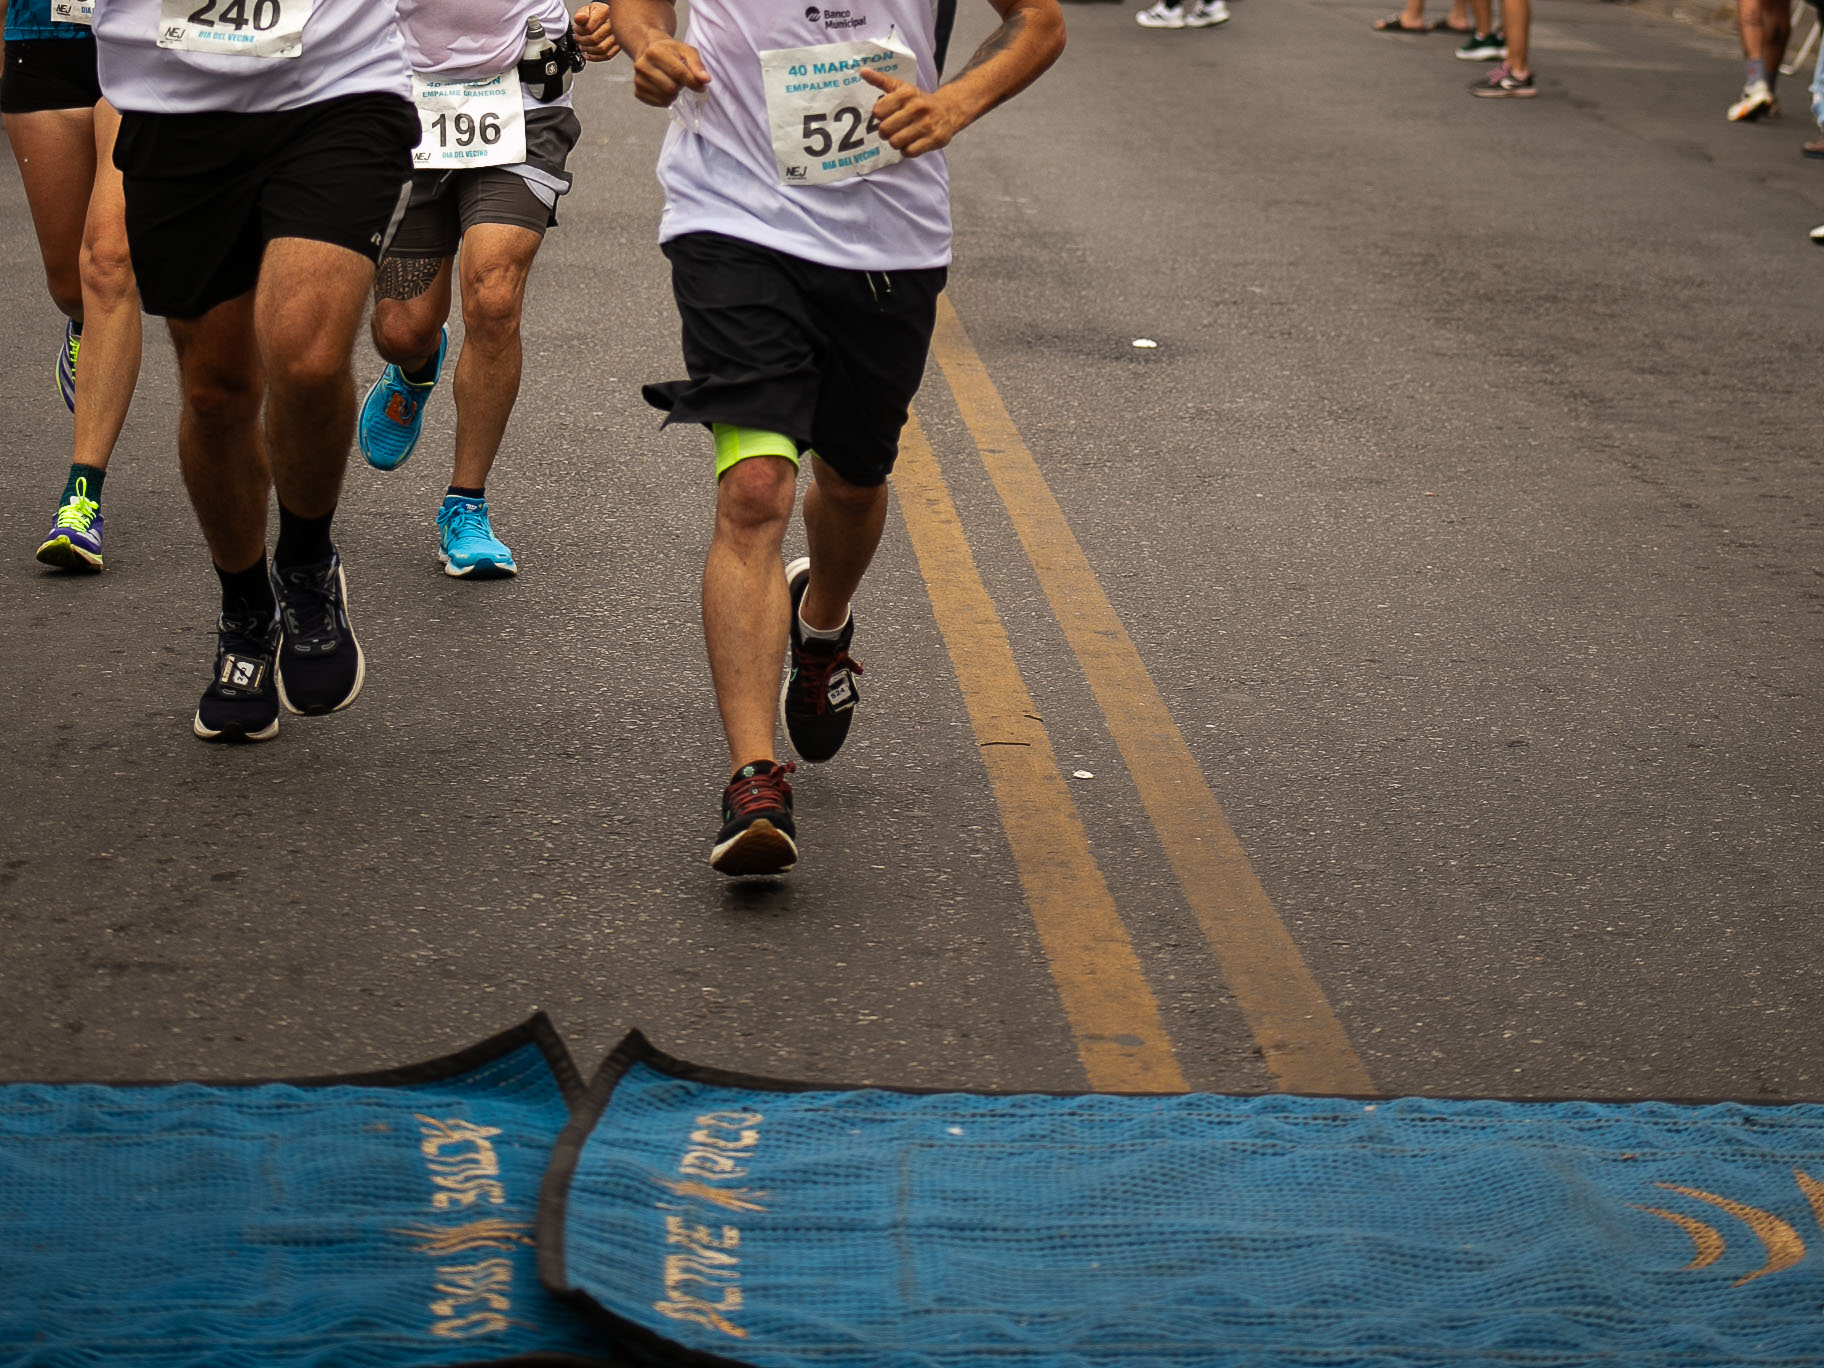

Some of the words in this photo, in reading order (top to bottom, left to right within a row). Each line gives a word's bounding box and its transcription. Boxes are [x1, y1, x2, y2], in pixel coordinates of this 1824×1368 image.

[56, 4, 72, 14] NEJ
[824, 9, 851, 20] Banco
[825, 16, 866, 30] Municipal
[164, 27, 186, 39] NEJ
[789, 64, 807, 76] 40
[813, 51, 894, 75] MARATON
[786, 79, 839, 93] EMPALME
[422, 90, 461, 98] EMPALME
[463, 88, 506, 97] GRANEROS
[431, 112, 501, 147] 196
[413, 153, 431, 161] NEJ
[442, 151, 453, 159] DIA
[822, 160, 837, 171] DIA
[838, 155, 852, 167] DEL
[853, 146, 880, 164] VECINO
[785, 166, 807, 177] NEJ
